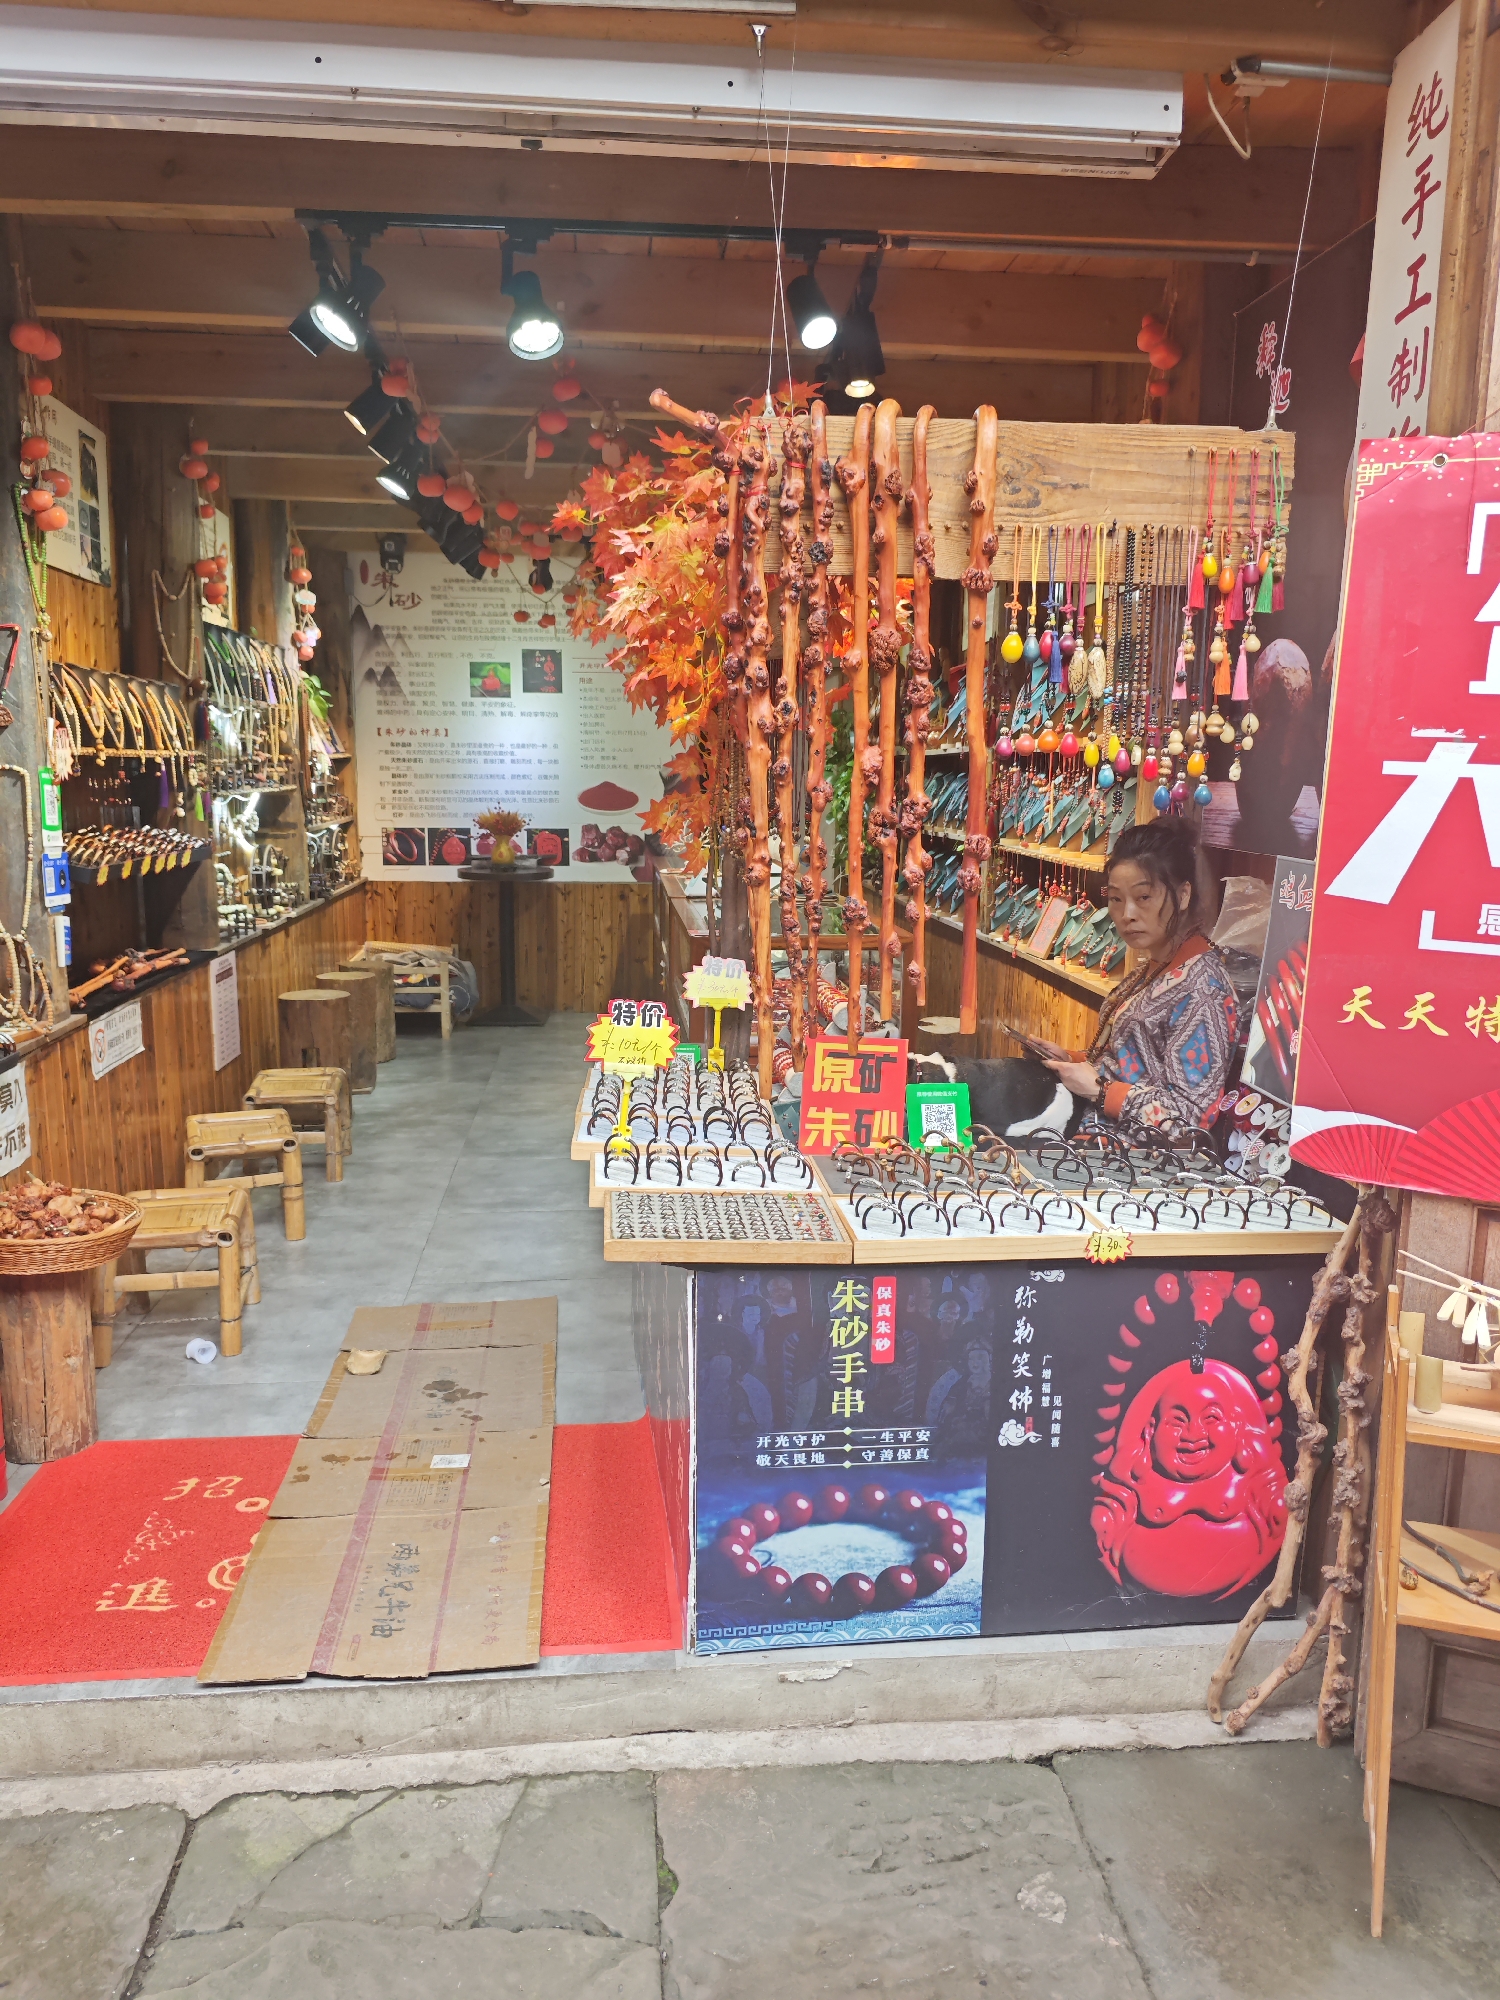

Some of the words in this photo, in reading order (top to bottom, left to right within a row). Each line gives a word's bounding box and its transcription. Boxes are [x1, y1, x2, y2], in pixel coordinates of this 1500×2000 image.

[704, 957, 744, 979] 特价
[612, 1002, 664, 1028] 特价
[811, 1042, 898, 1094] 原矿
[804, 1106, 898, 1148] 朱砂
[874, 1286, 893, 1352] 保真朱砂
[829, 1280, 869, 1418] 朱砂手串
[1009, 1285, 1037, 1413] 弥勒笑佛
[756, 1433, 826, 1449] 开光守护
[862, 1430, 931, 1443] 一生平安
[1051, 1395, 1062, 1448] 见闻随喜
[756, 1452, 825, 1467] 敬天畏地
[862, 1448, 930, 1462] 守善保真
